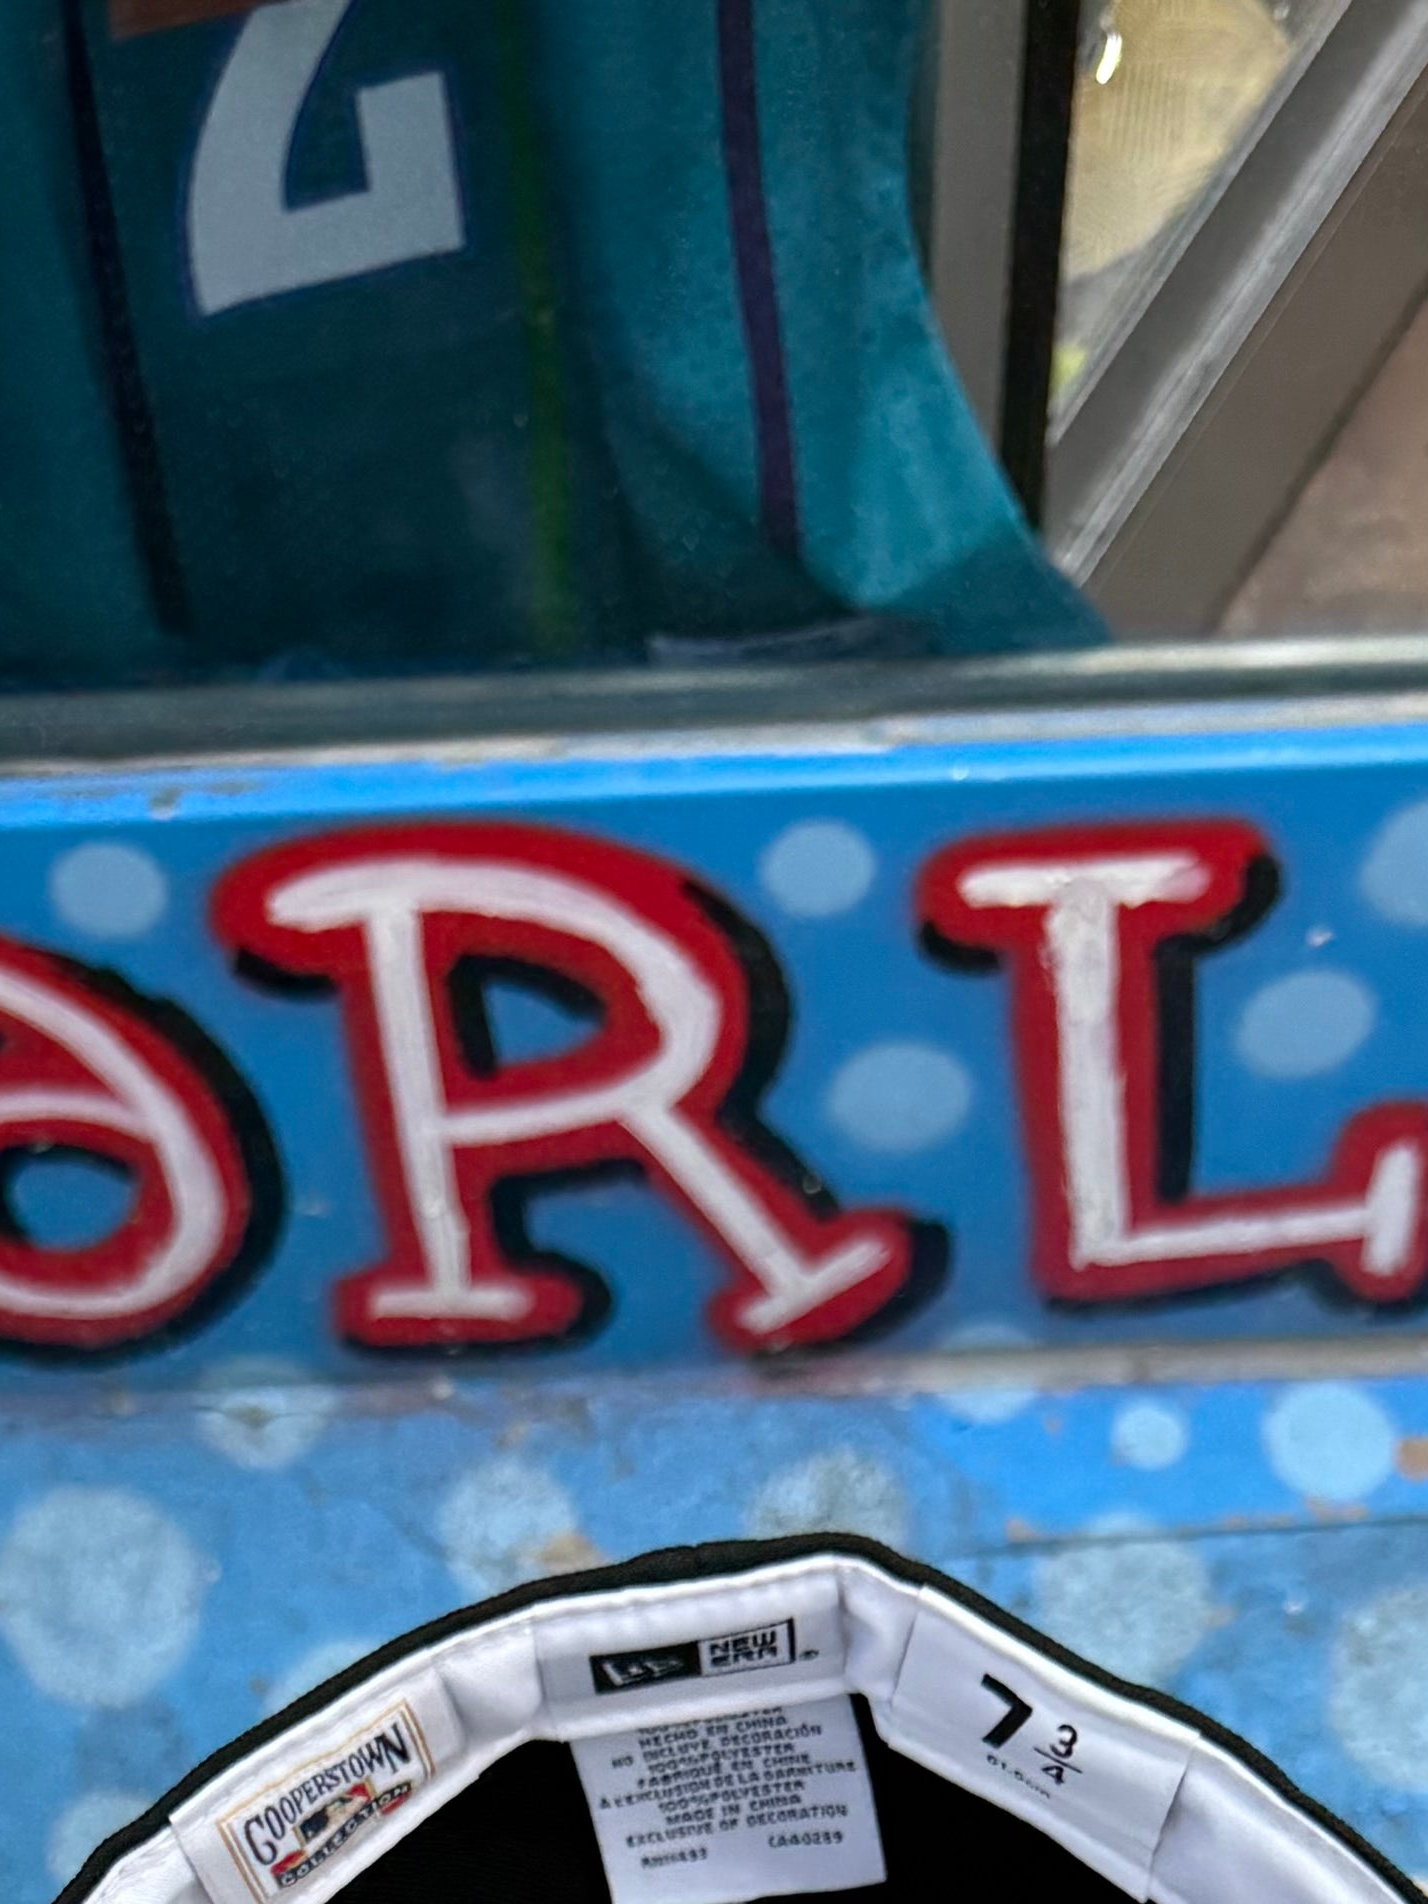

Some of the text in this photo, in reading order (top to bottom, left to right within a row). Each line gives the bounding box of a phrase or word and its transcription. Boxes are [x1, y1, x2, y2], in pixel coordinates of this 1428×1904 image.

[709, 1629, 776, 1656] NEW
[710, 1647, 778, 1667] ERA
[736, 1715, 787, 1733] CHINA
[980, 1673, 1033, 1749] 7
[243, 1722, 411, 1866] COOPERSTOWN
[722, 1804, 741, 1817] IN
[750, 1795, 803, 1811] CHINA
[747, 1804, 849, 1829] DECORATION
[276, 1780, 414, 1888] COLLECTION
